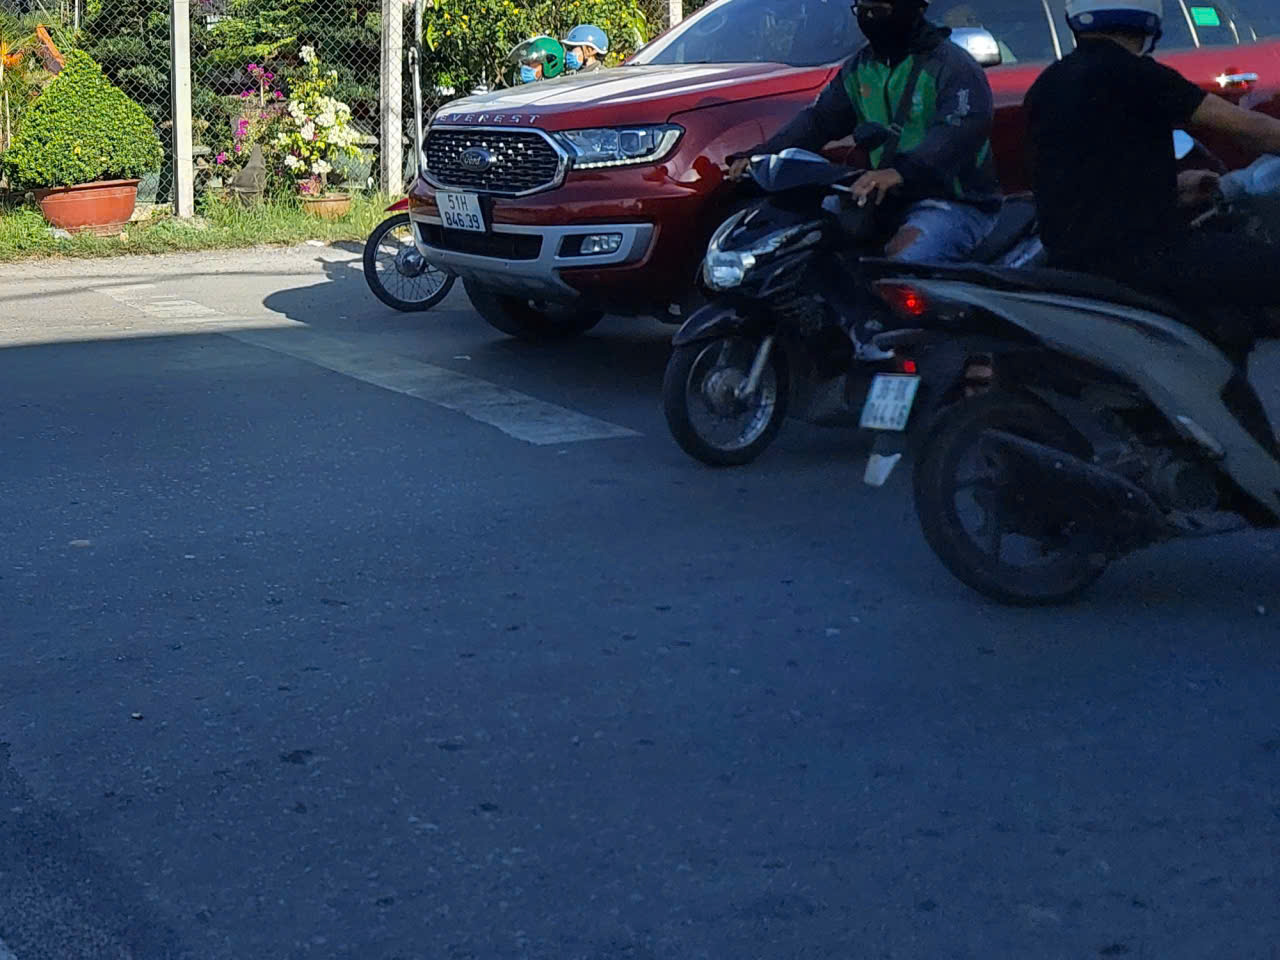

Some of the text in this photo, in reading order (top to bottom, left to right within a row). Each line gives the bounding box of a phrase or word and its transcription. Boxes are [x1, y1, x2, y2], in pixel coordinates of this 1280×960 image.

[437, 112, 542, 125] EVEREST
[463, 153, 481, 166] Ford
[447, 193, 469, 212] 51H
[443, 210, 481, 230] 846.39
